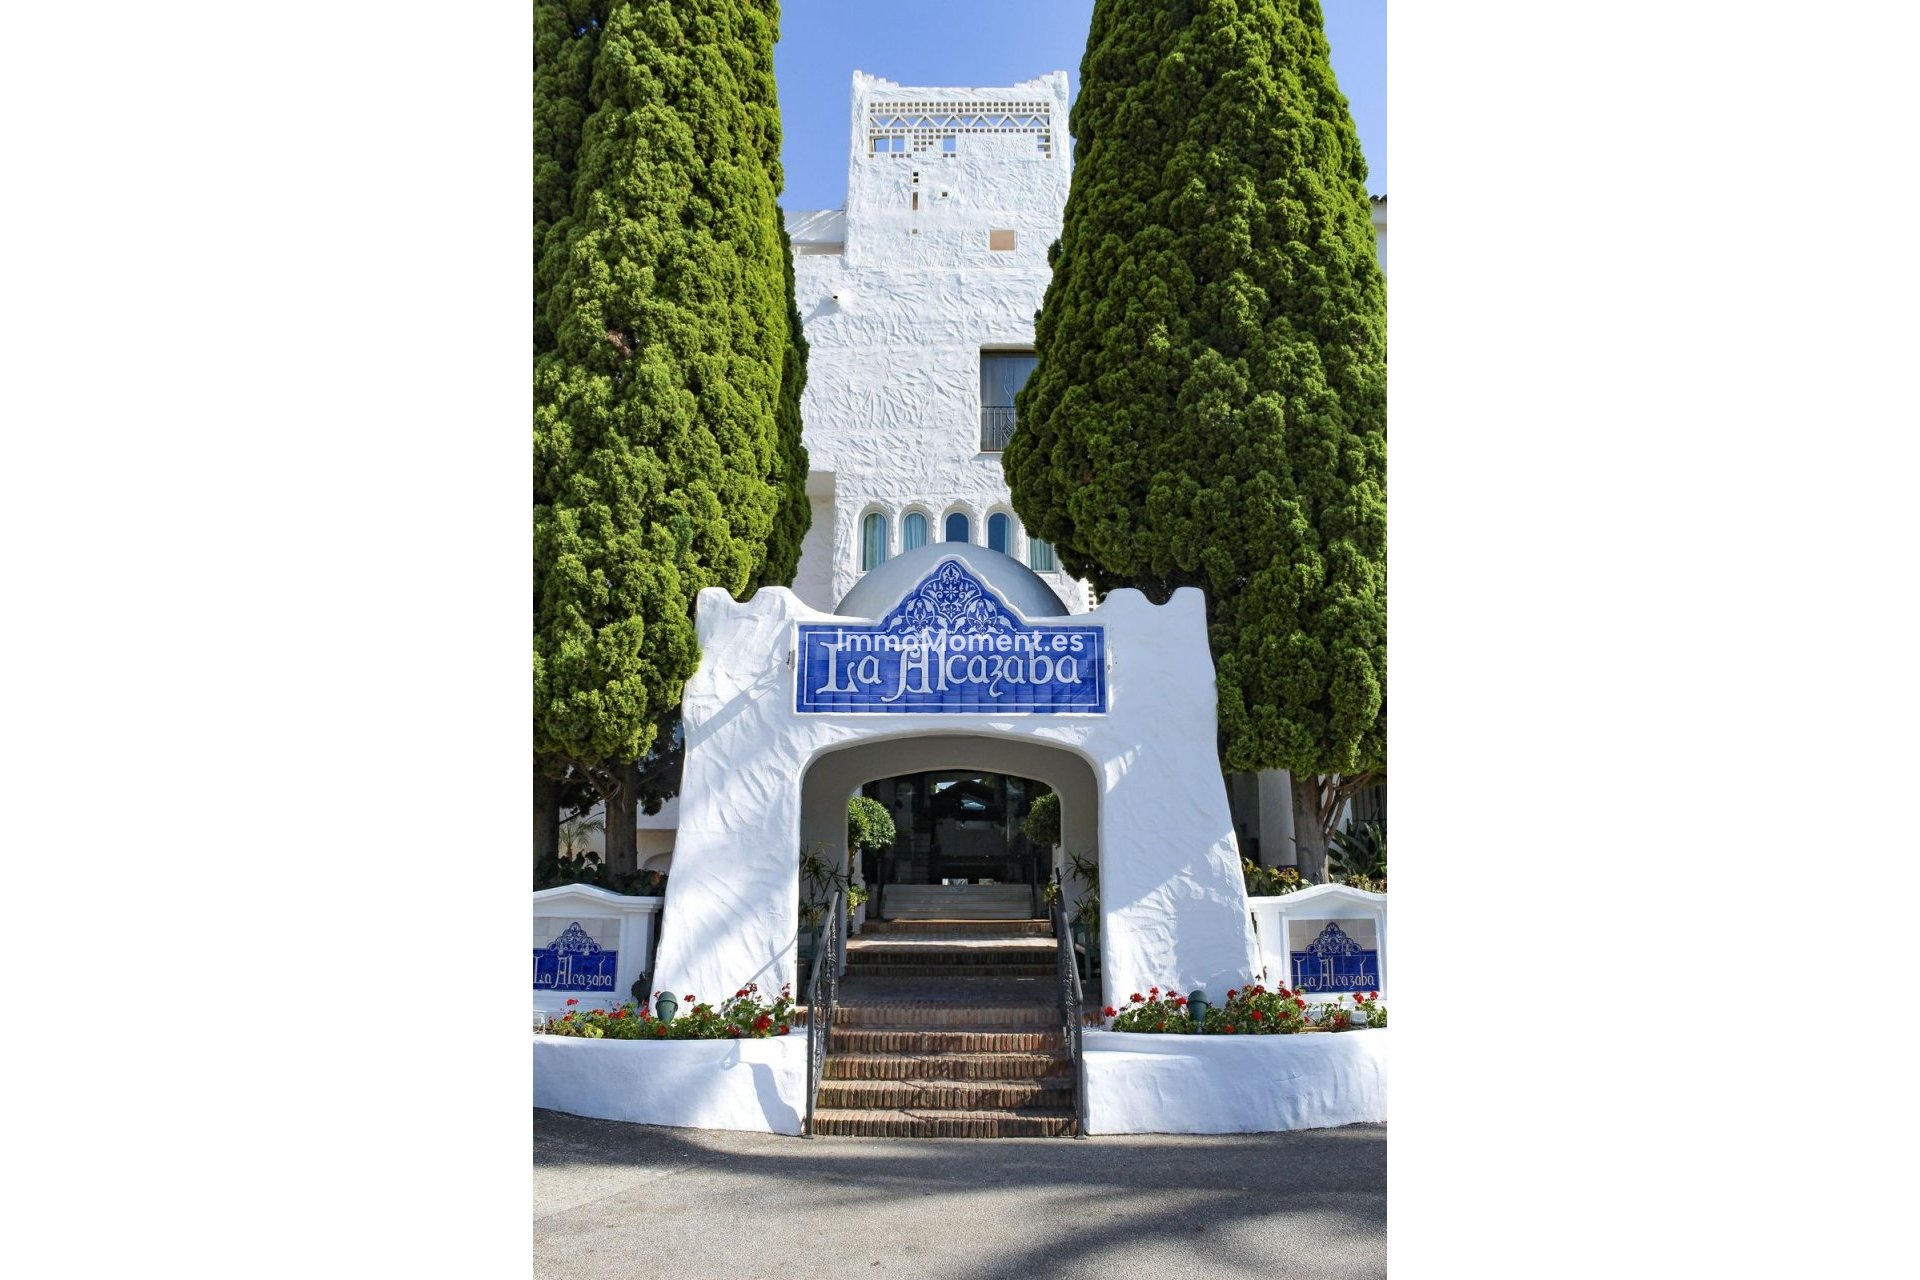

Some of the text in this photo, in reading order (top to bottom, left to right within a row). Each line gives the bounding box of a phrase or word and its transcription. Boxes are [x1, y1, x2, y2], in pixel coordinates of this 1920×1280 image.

[816, 637, 1082, 702] La Alcazaba
[533, 954, 612, 989] La Alcazaba
[1293, 955, 1375, 990] La Alcazaba
